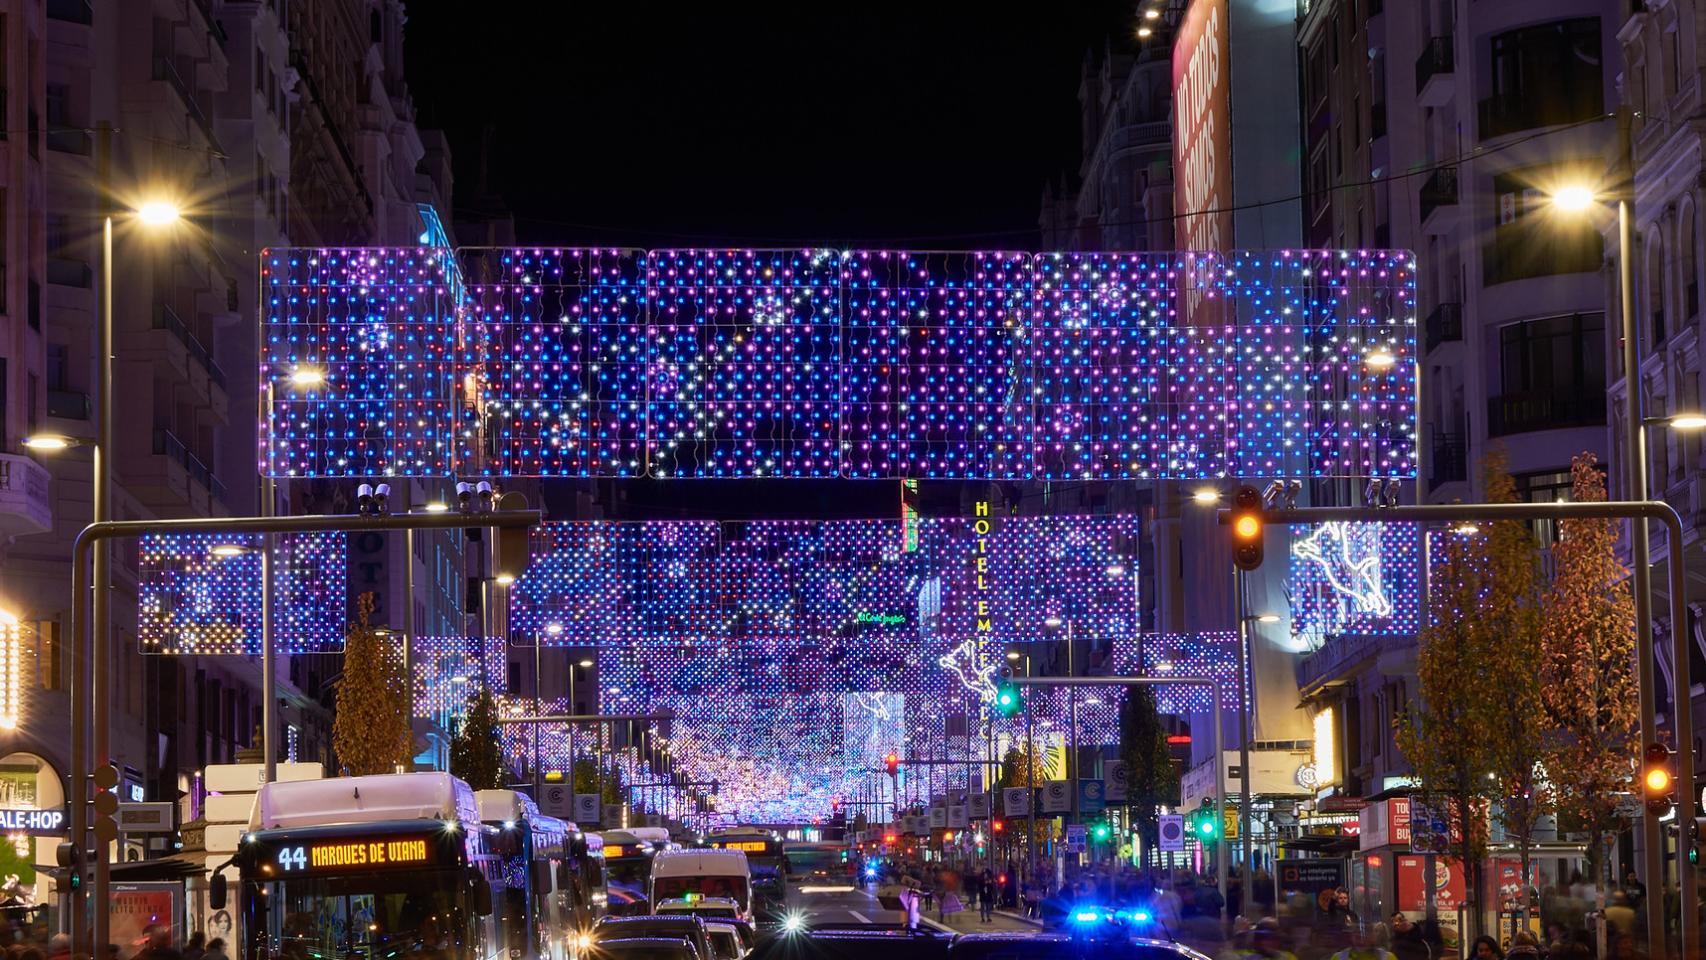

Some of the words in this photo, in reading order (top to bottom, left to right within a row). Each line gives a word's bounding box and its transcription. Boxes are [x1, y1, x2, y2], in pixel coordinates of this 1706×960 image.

[1177, 73, 1189, 162] NO
[1189, 6, 1219, 133] TODOS
[1185, 110, 1215, 234] SOMOS
[975, 501, 989, 590] HOTEL
[0, 811, 63, 829] ALE-HOP
[278, 846, 307, 871] 44
[312, 844, 366, 866] MARQUES
[370, 843, 385, 863] DE
[388, 840, 426, 861] VIANA
